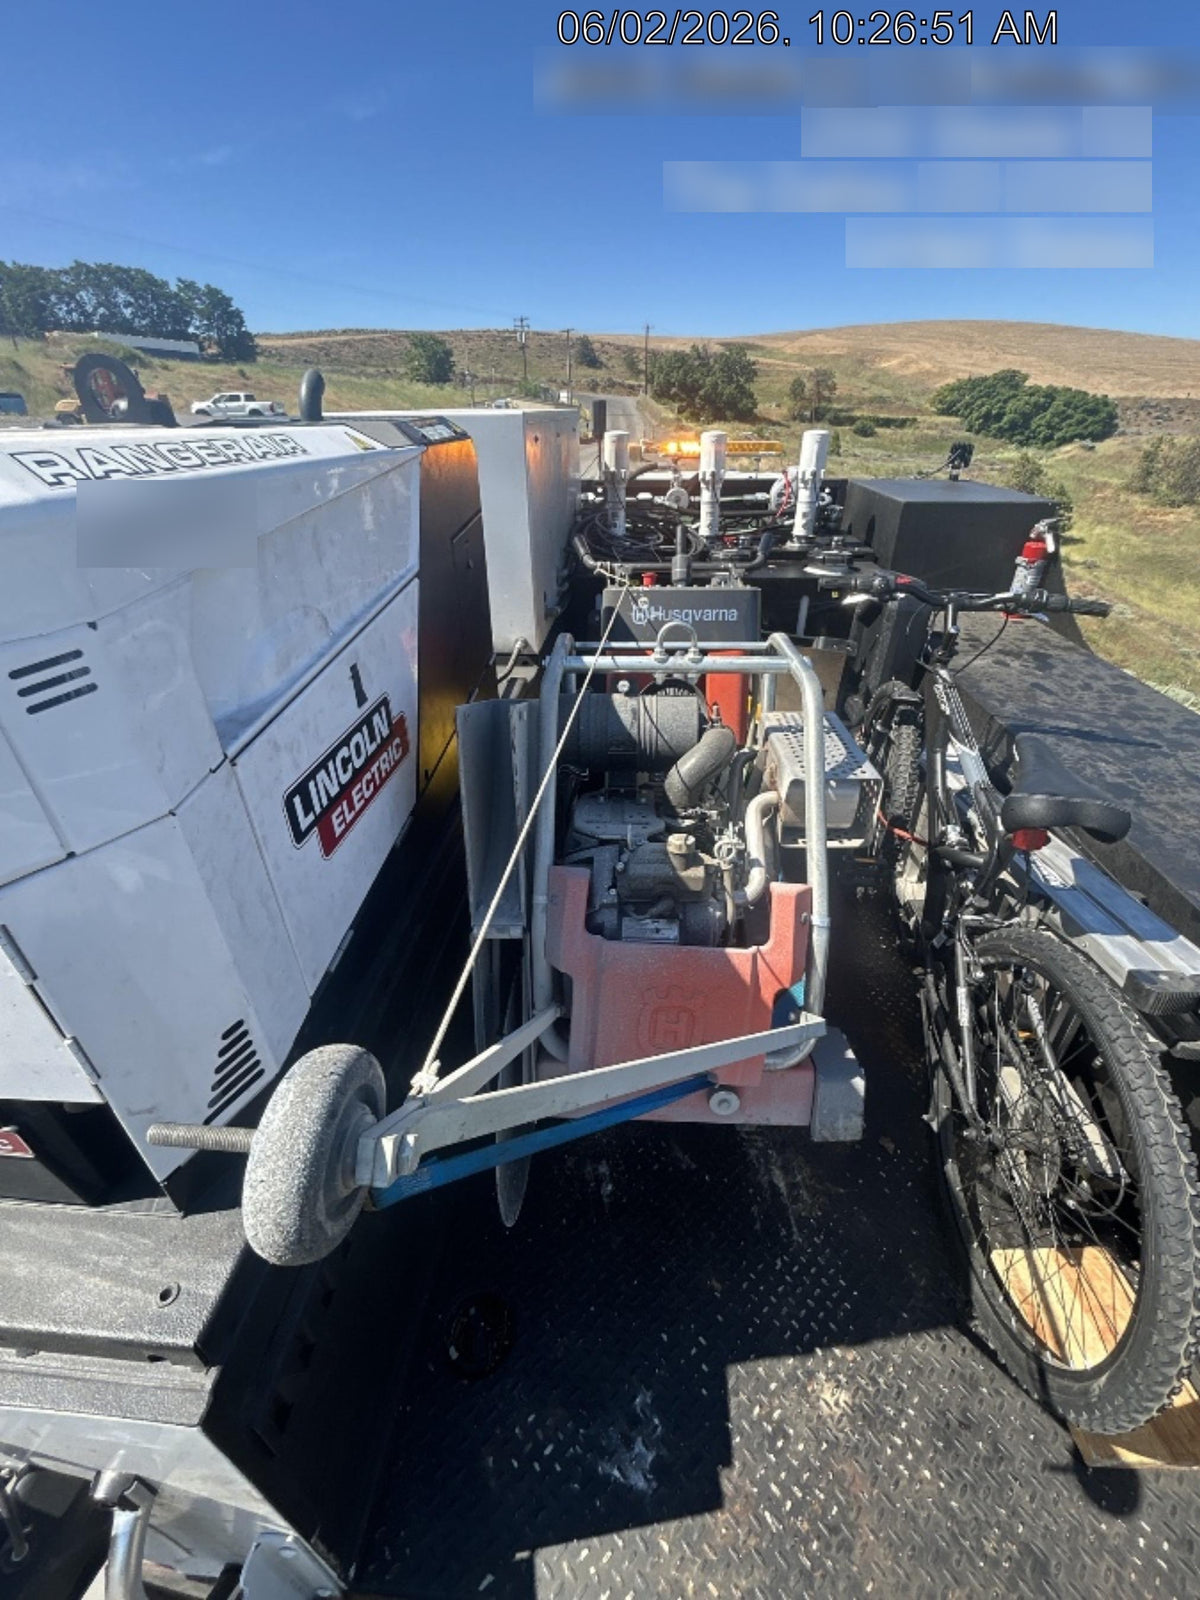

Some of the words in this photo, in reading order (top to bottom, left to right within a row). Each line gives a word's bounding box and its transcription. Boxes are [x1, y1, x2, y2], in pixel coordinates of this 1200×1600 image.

[649, 605, 738, 624] Husqvarna
[292, 705, 391, 833] LINCOLN
[330, 736, 403, 839] ELECTRIC
